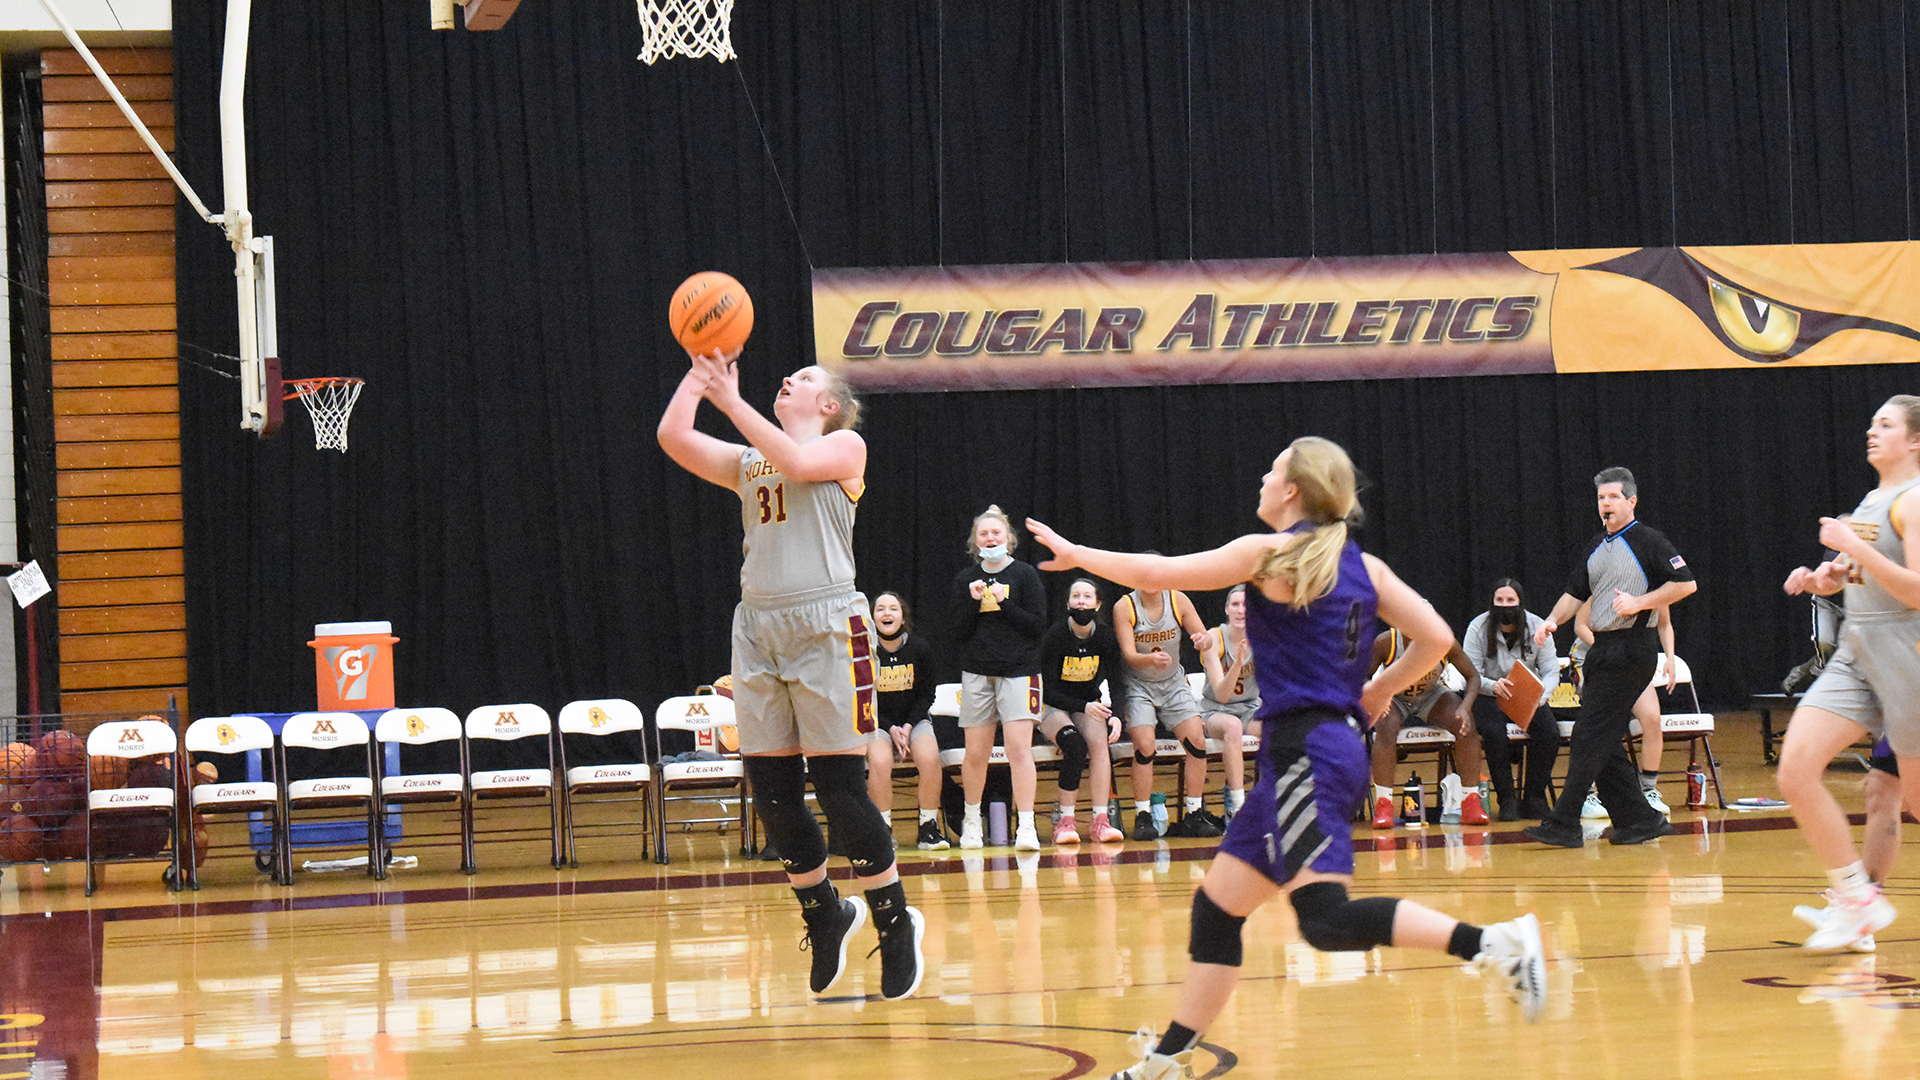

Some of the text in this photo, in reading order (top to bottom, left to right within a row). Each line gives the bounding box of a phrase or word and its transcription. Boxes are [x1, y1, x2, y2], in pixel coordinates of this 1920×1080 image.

[841, 293, 1539, 358] COUGAR ATHLETICS
[756, 482, 787, 525] 31
[1134, 628, 1176, 643] MORRIS
[339, 649, 363, 676] G
